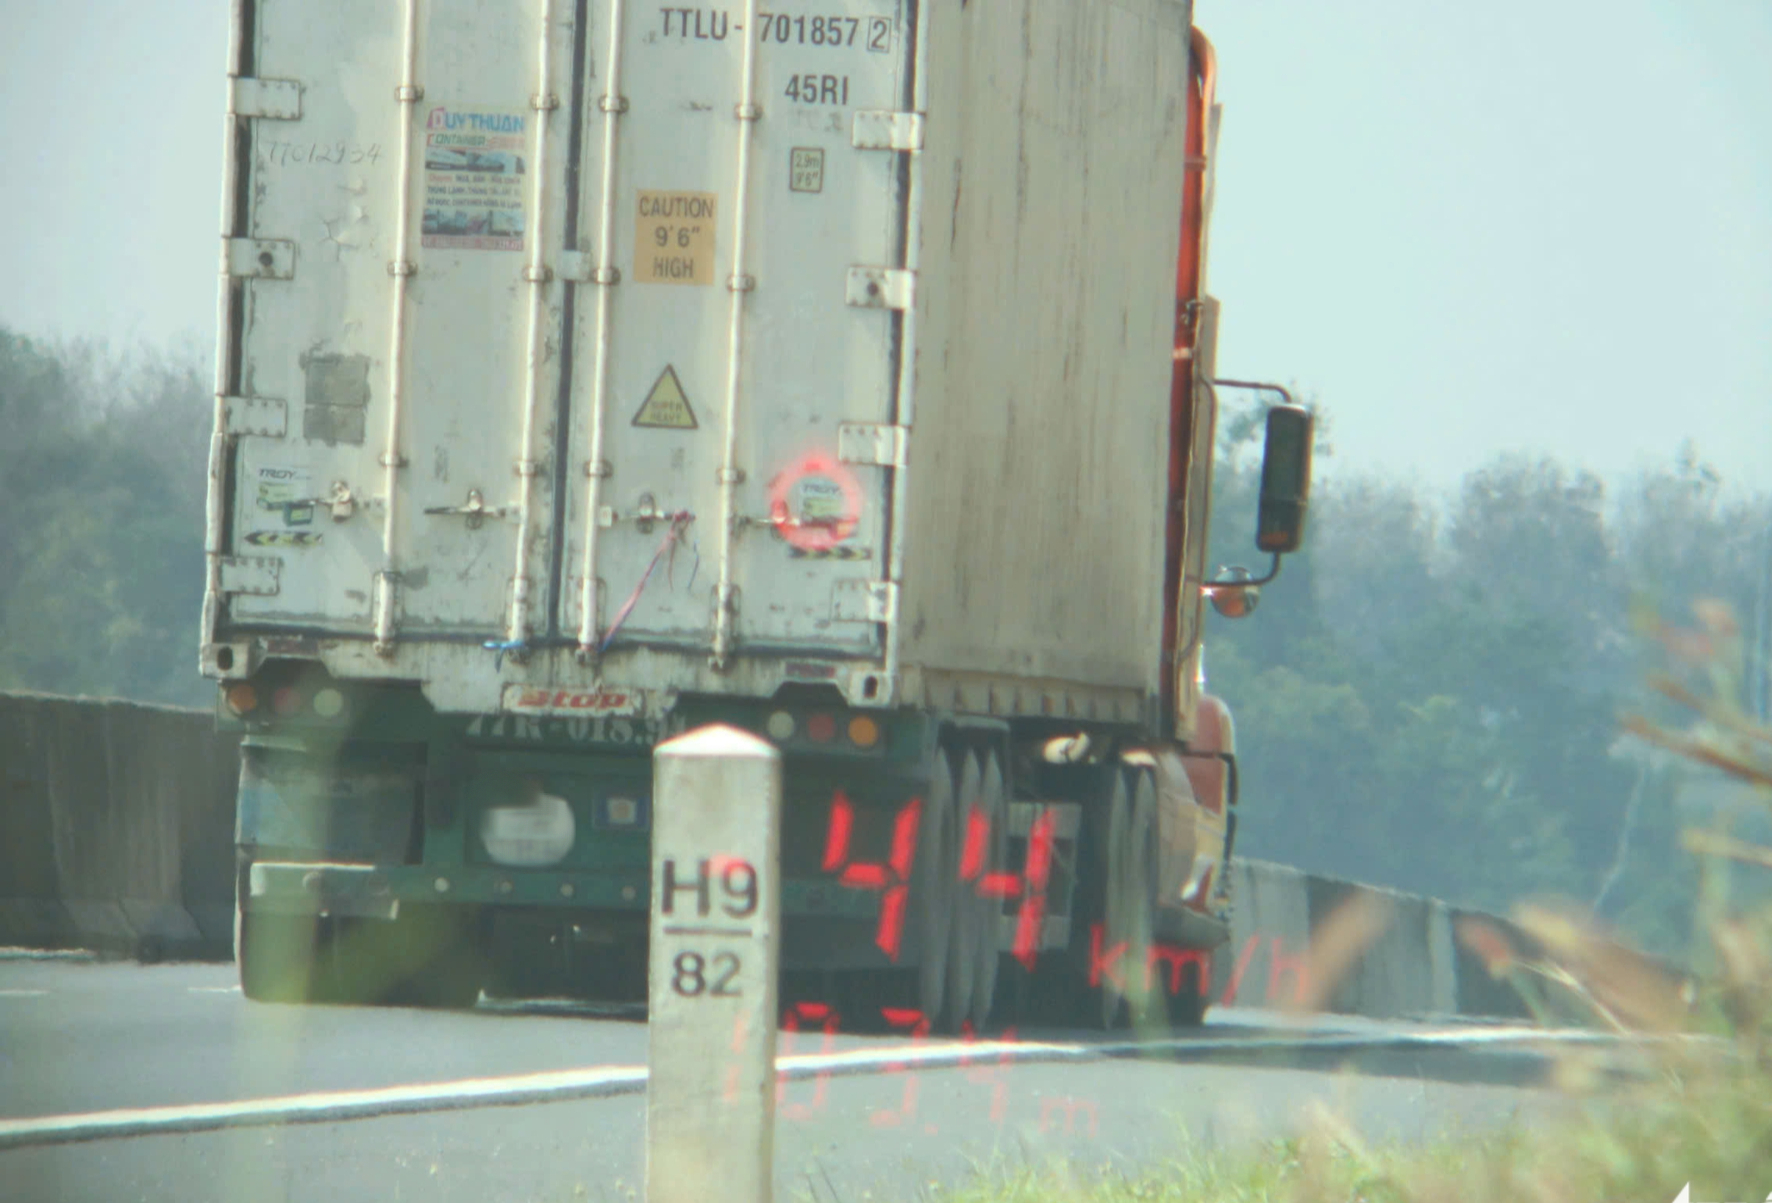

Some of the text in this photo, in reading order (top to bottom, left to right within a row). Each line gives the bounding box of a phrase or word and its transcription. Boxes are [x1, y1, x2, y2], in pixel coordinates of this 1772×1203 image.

[660, 8, 887, 49] TTLU- 701857 2
[639, 197, 714, 218] CAUTION
[653, 257, 694, 279] HIGH
[661, 859, 759, 919] H9
[823, 791, 1312, 1010] 44 km/h
[672, 951, 743, 997] 82
